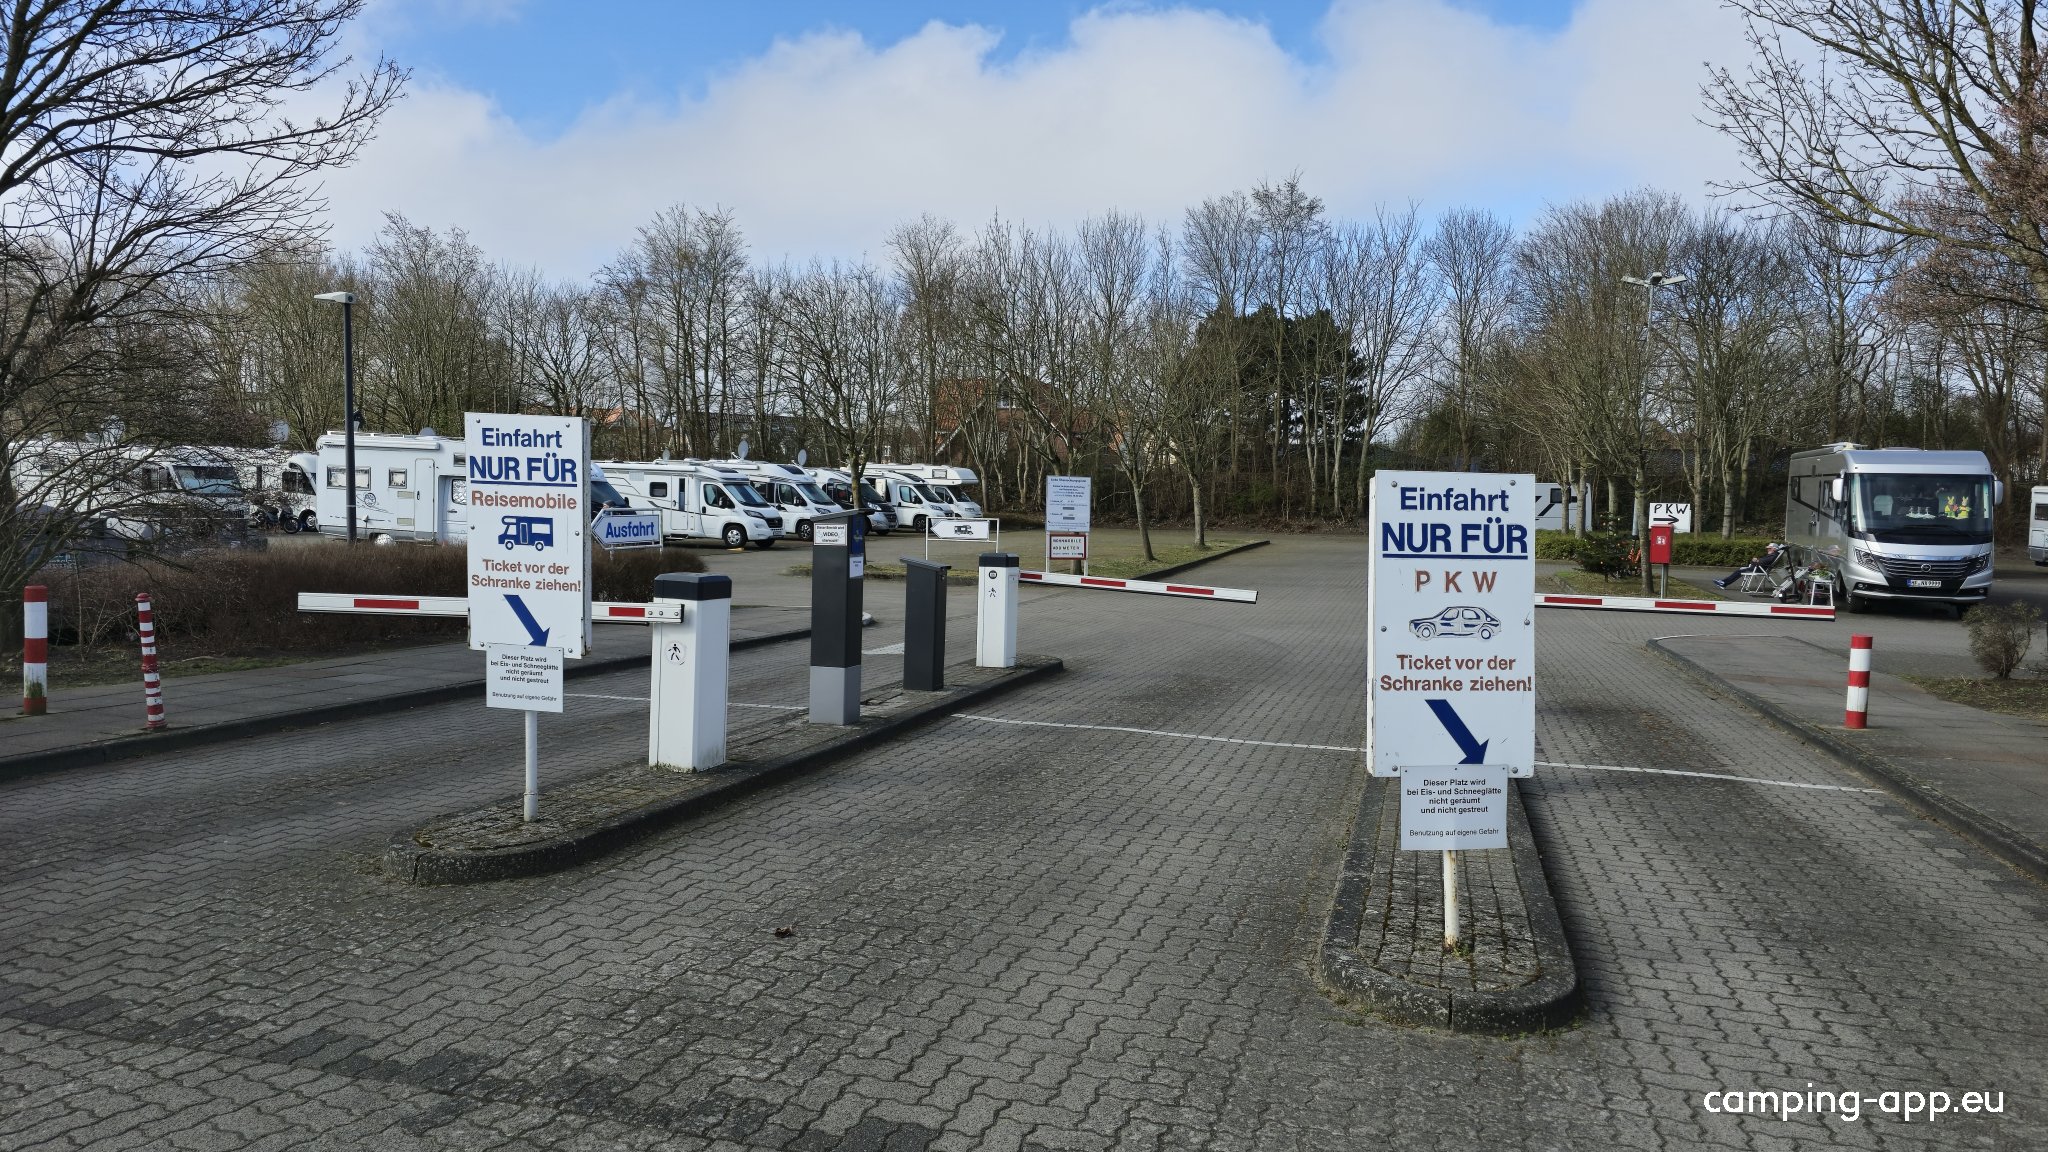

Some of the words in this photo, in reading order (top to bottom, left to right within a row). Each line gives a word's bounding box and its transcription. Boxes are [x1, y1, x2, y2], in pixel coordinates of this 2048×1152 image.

[481, 427, 563, 449] Einfahrt
[469, 455, 521, 481] NUR
[527, 452, 577, 482] FÜR
[471, 490, 577, 510] Reisemobile
[1400, 487, 1509, 512] Einfahrt
[605, 521, 655, 538] Ausfahrt
[1382, 522, 1451, 553] NUR
[1462, 517, 1528, 554] FÜR
[483, 558, 522, 573] Ticket
[524, 563, 545, 574] vor
[548, 562, 570, 576] der
[471, 575, 531, 590] Schranke
[536, 578, 582, 592] ziehen!
[1397, 654, 1451, 671] Ticket
[1455, 658, 1483, 671] vor
[1487, 655, 1516, 671] der
[1380, 675, 1463, 692] Schranke
[1470, 675, 1532, 692] ziehen!
[1470, 778, 1486, 786] wird
[1406, 788, 1419, 796] bei
[1420, 788, 1436, 796] Eis-
[1454, 787, 1502, 796] Schneeglätte
[1429, 797, 1448, 805] nicht
[1450, 797, 1480, 806] geräumt
[1458, 806, 1488, 814] gestreut
[1409, 829, 1444, 838] Benutzung
[1457, 829, 1477, 837] eigene
